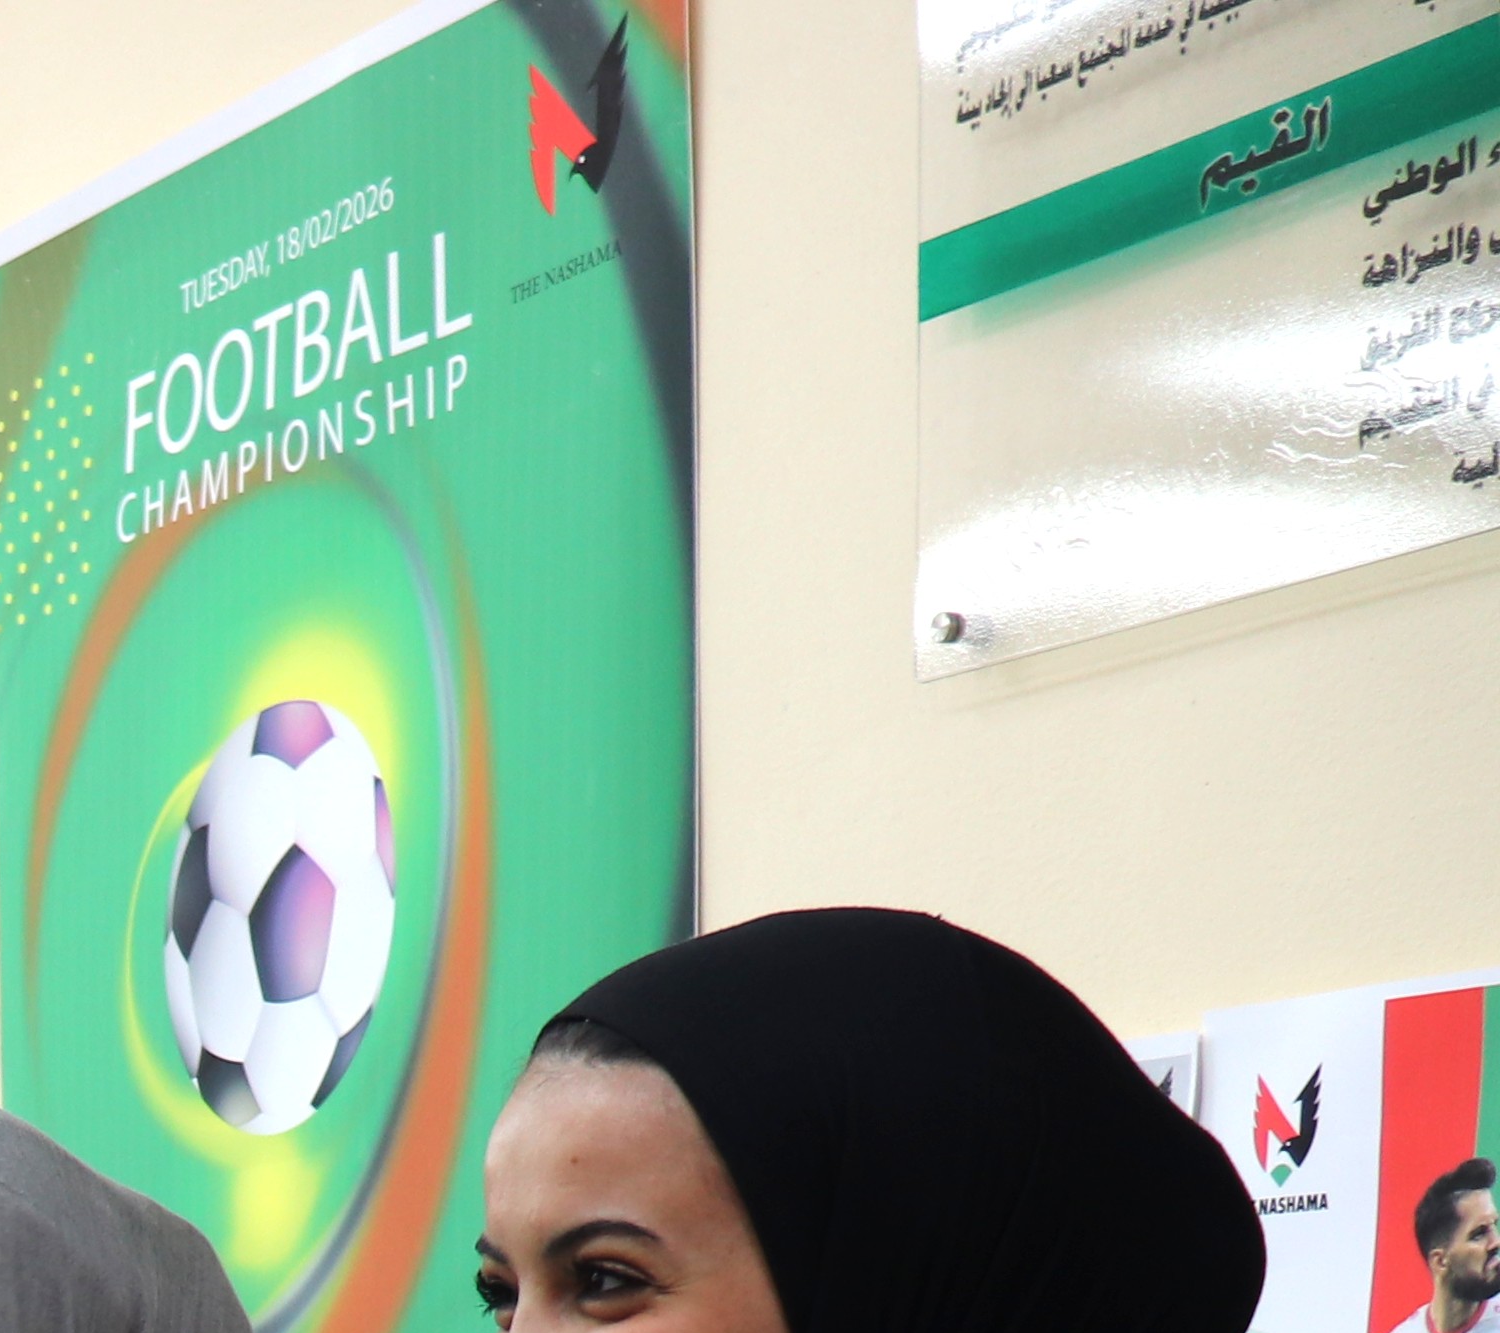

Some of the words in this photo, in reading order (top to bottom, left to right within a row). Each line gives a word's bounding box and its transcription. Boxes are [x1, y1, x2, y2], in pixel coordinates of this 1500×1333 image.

[1077, 27, 1132, 88] المجتمع
[1200, 96, 1332, 212] القيم
[1363, 135, 1478, 226] الوطني
[180, 241, 271, 314] TUESDAY,
[276, 177, 395, 266] 18/02/2026
[509, 281, 541, 305] THE
[543, 239, 624, 286] NASHAMA
[1362, 222, 1482, 288] والنزاهة
[124, 231, 473, 475] FOOTBALL
[1360, 305, 1442, 372] الفريق
[115, 354, 469, 544] CHAMPIONSHIP
[1259, 1192, 1329, 1216] NASHAMA
